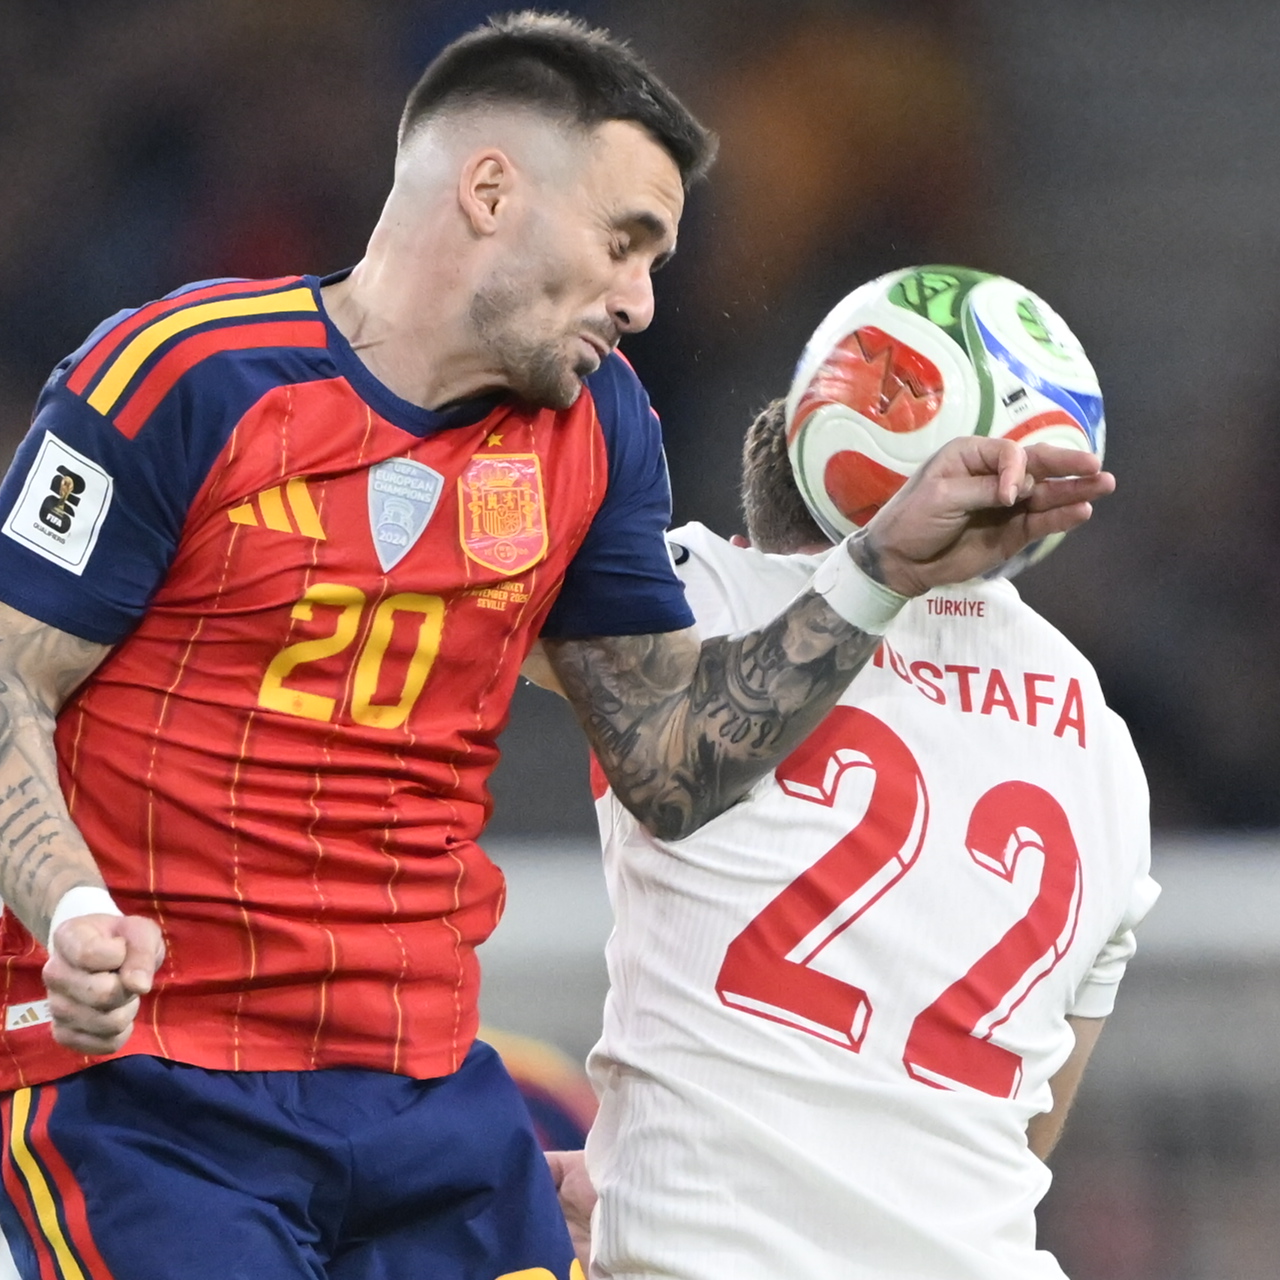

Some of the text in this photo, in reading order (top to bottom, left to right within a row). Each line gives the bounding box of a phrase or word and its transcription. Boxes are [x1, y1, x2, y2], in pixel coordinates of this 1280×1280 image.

[373, 480, 433, 504] CHAMPIONS
[375, 469, 434, 493] EUROPEAN
[379, 530, 408, 547] 2024
[476, 597, 507, 612] SEVILLE
[926, 596, 985, 618] TÜRKİYE
[257, 582, 446, 730] 20
[715, 704, 1084, 1101] 22
